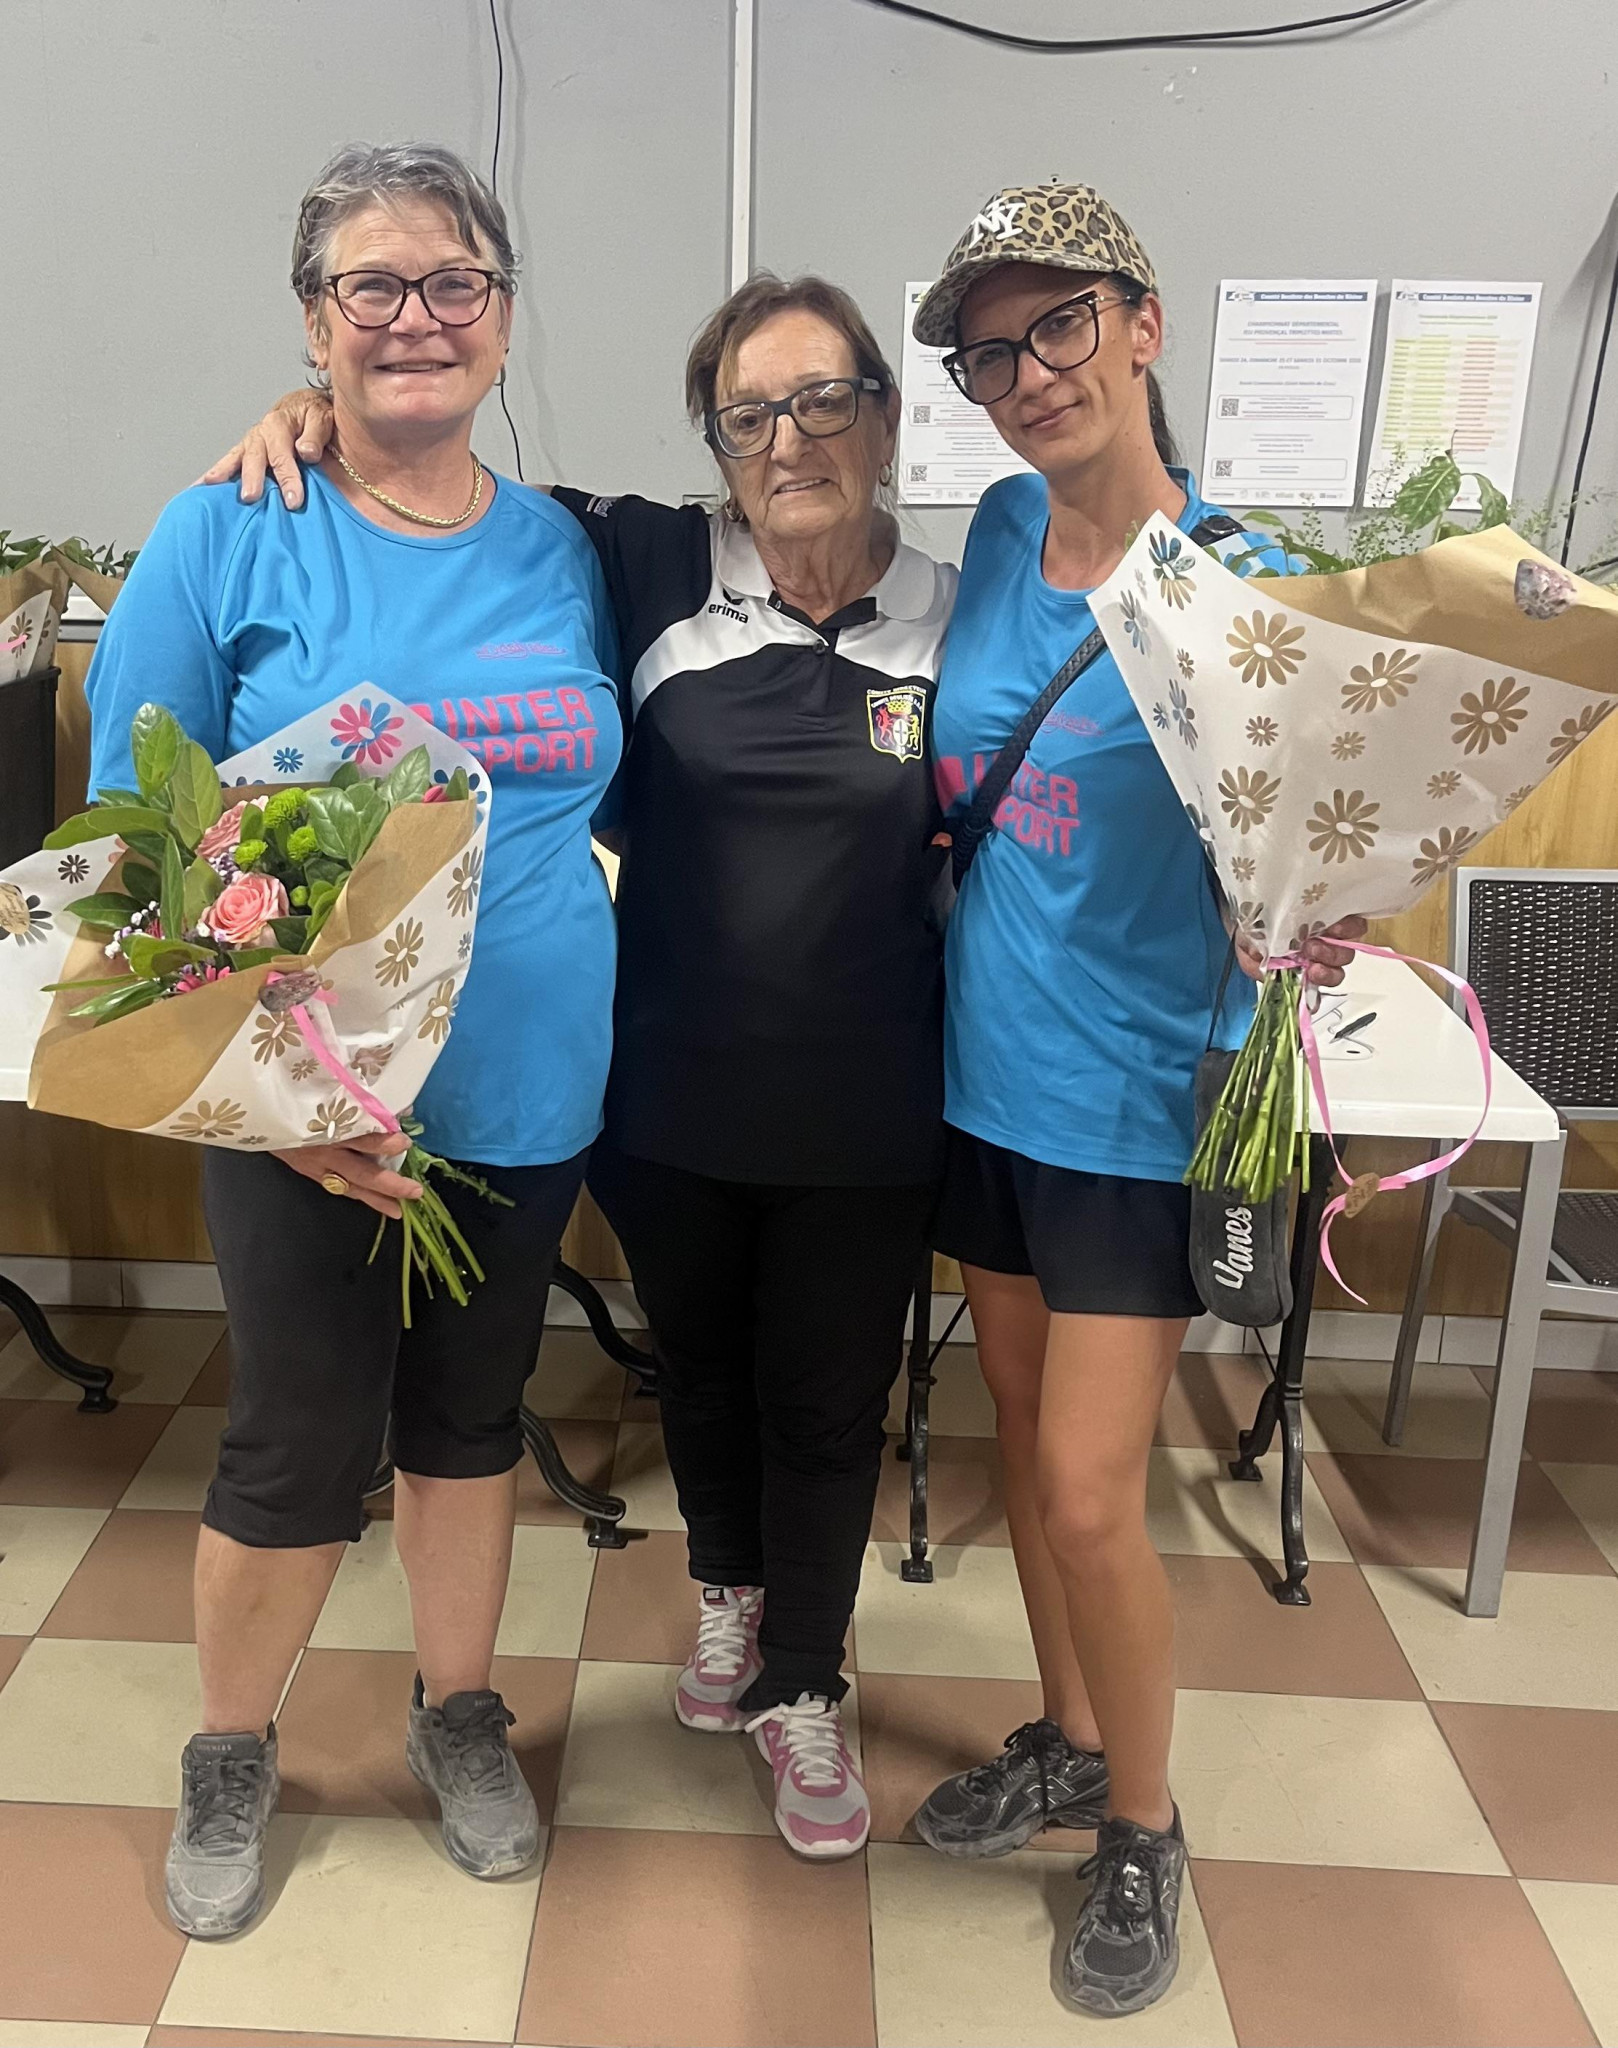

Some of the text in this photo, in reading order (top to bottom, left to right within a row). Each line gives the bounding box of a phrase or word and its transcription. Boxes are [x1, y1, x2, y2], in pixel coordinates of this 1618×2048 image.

[708, 602, 749, 624] erima
[442, 687, 595, 739] INTER
[973, 751, 1078, 815] ITER
[991, 794, 1080, 857] PORT
